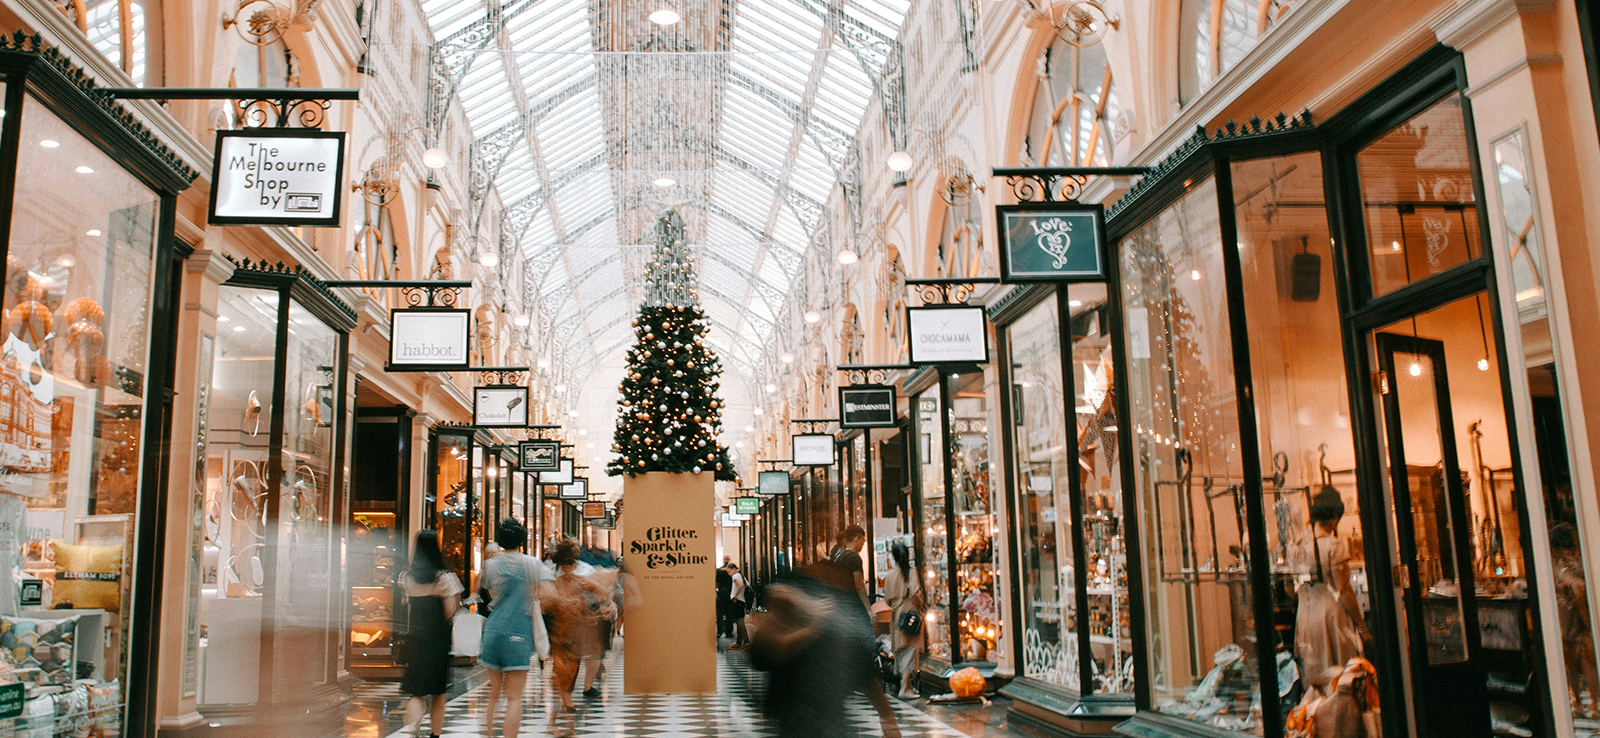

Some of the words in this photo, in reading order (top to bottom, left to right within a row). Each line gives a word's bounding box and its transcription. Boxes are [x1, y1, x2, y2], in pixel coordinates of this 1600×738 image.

[248, 143, 279, 157] The
[229, 156, 327, 172] Melbourne
[244, 173, 289, 193] Shop
[260, 195, 281, 209] by
[630, 540, 687, 555] Sparkle
